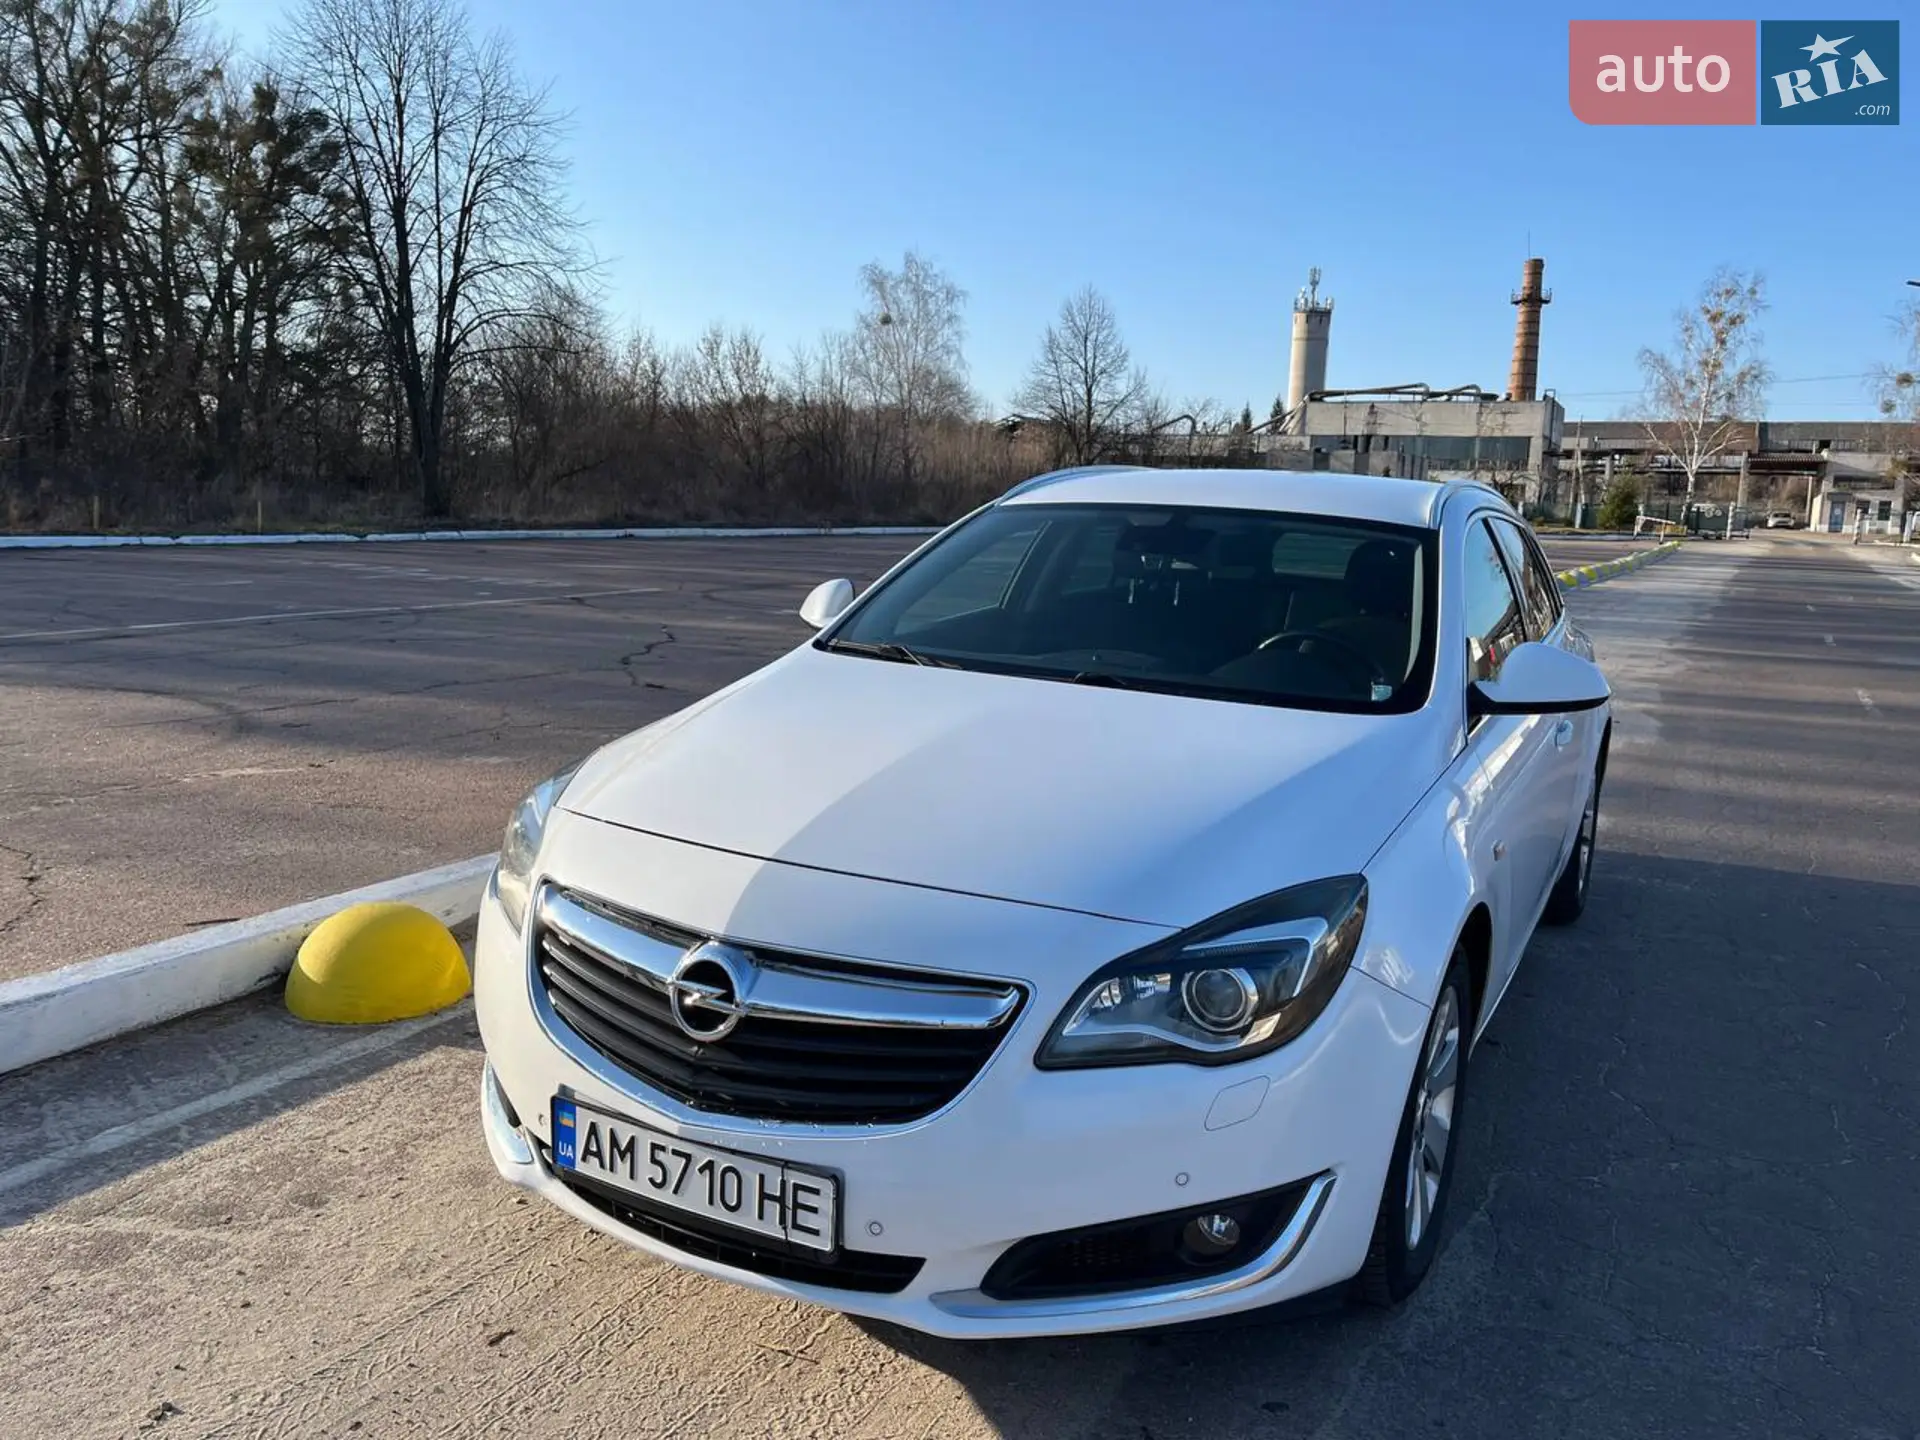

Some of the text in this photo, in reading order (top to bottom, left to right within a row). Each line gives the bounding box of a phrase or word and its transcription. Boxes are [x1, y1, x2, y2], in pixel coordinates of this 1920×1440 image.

[558, 1141, 574, 1160] UA
[580, 1121, 821, 1237] AM 5710 HE
